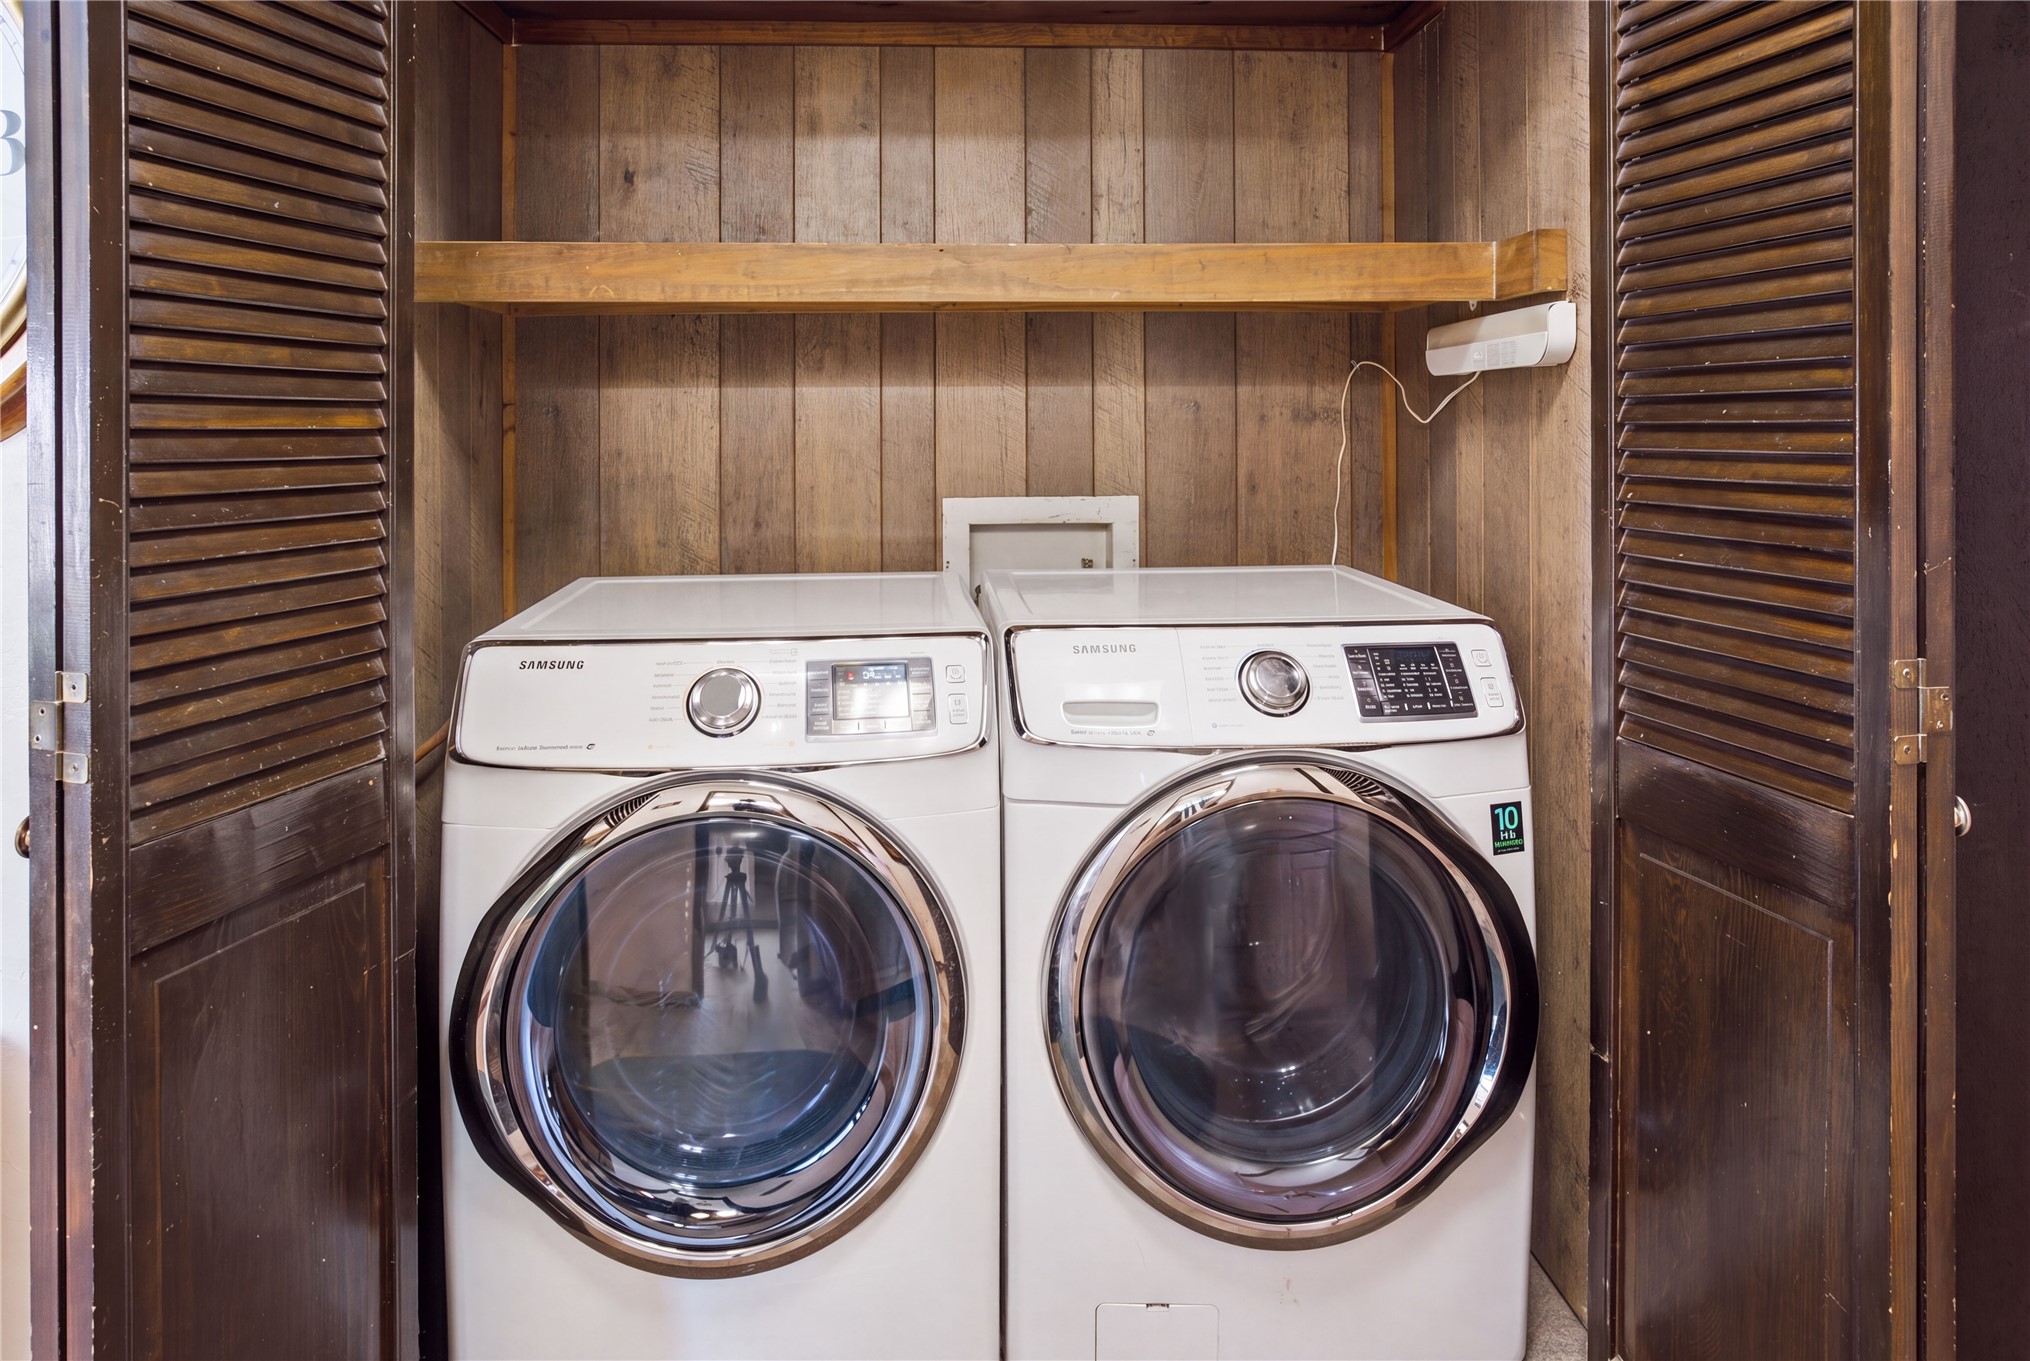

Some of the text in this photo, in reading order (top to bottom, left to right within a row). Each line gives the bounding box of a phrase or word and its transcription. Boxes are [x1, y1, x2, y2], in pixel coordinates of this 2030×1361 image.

[1073, 643, 1136, 655] SAMSUNG
[519, 660, 585, 670] SAMSUNG
[1494, 806, 1519, 831] 10
